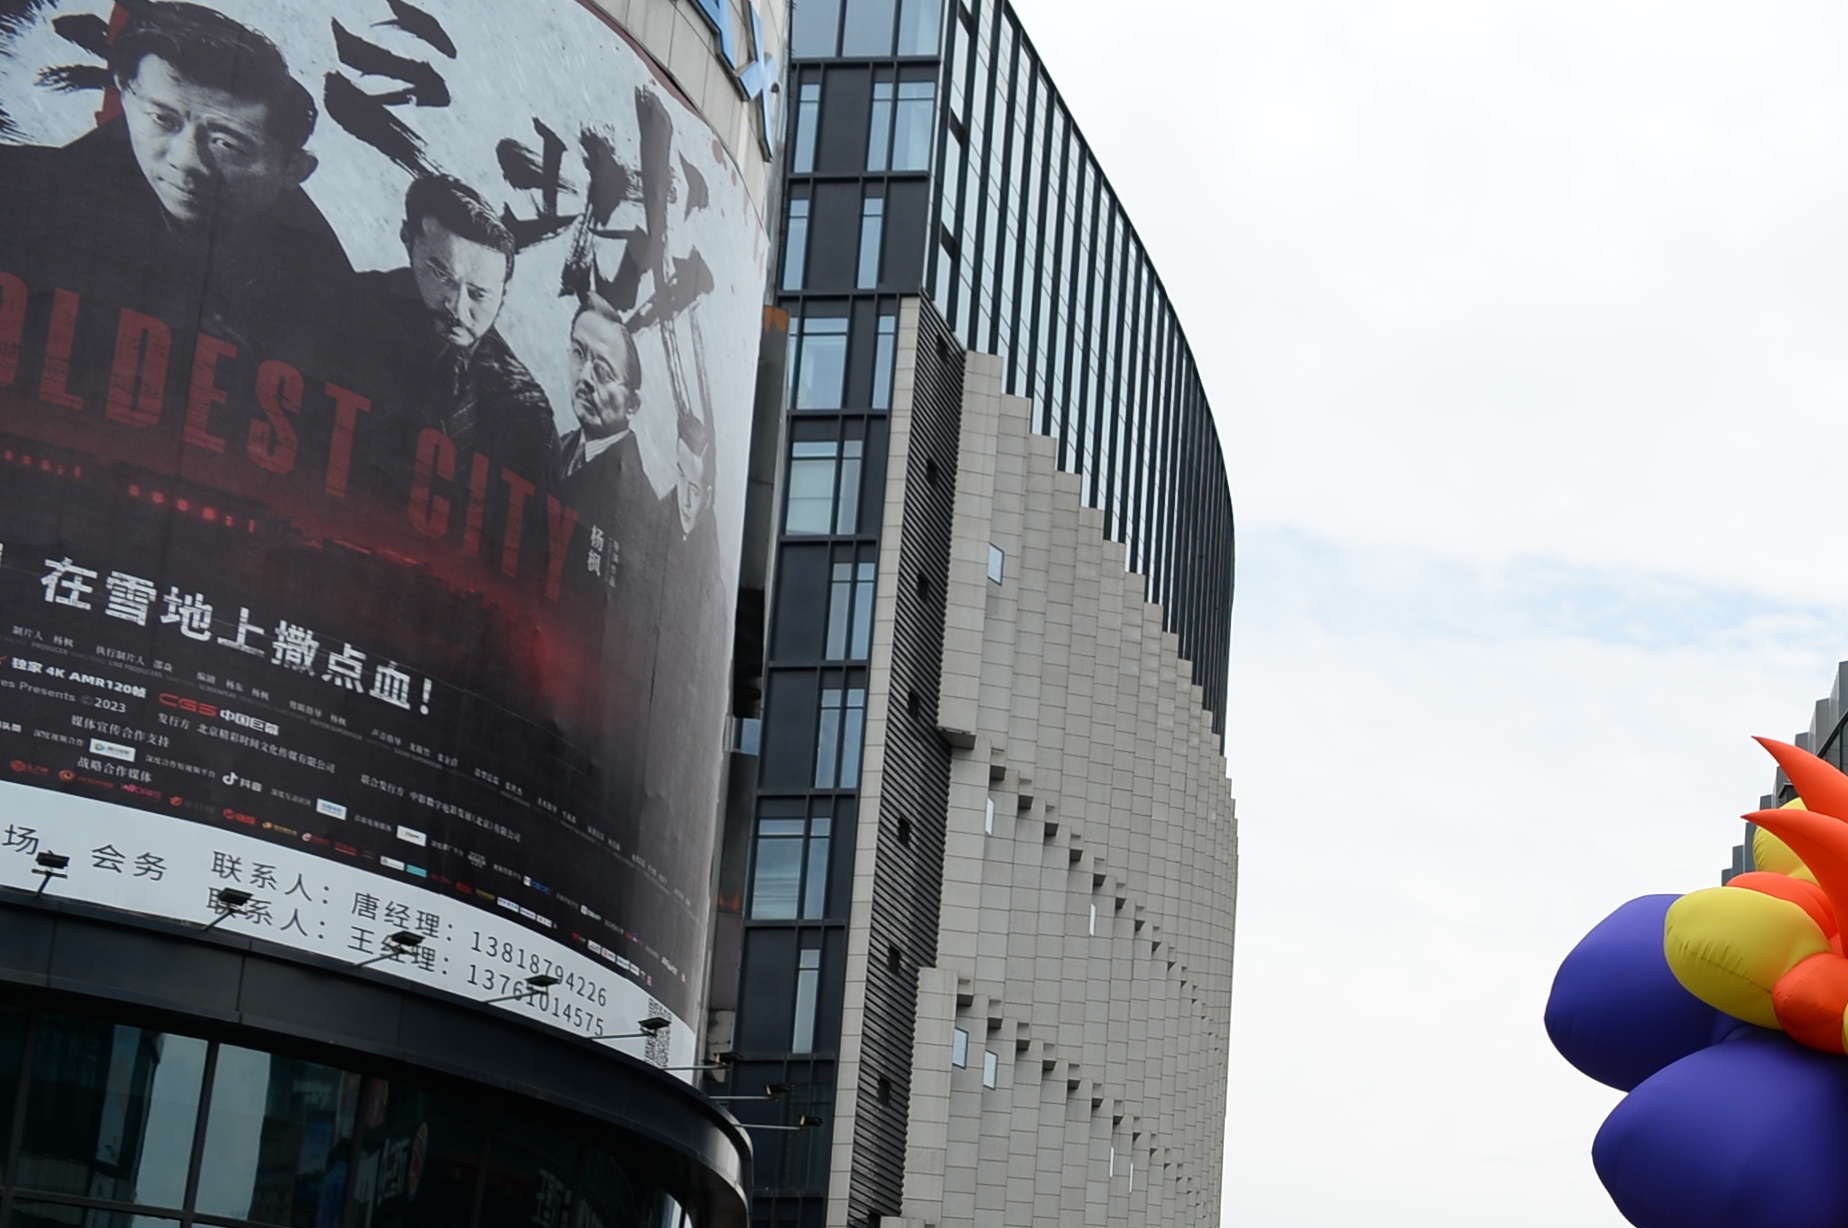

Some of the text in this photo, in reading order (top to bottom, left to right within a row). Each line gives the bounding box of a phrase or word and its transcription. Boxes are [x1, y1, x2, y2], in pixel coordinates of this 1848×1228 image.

[407, 428, 577, 600] CITY
[12, 625, 44, 641] 制片人
[11, 657, 43, 673] 独家
[45, 666, 66, 679] 4K
[220, 709, 279, 736] 中国巨幕
[19, 681, 76, 701] Presents
[71, 715, 170, 748] 媒体宣传合作支持
[158, 712, 191, 730] 发行方
[77, 756, 153, 783] 战略合作媒体
[239, 777, 263, 793] 抖音
[471, 931, 607, 1008] 13818794226
